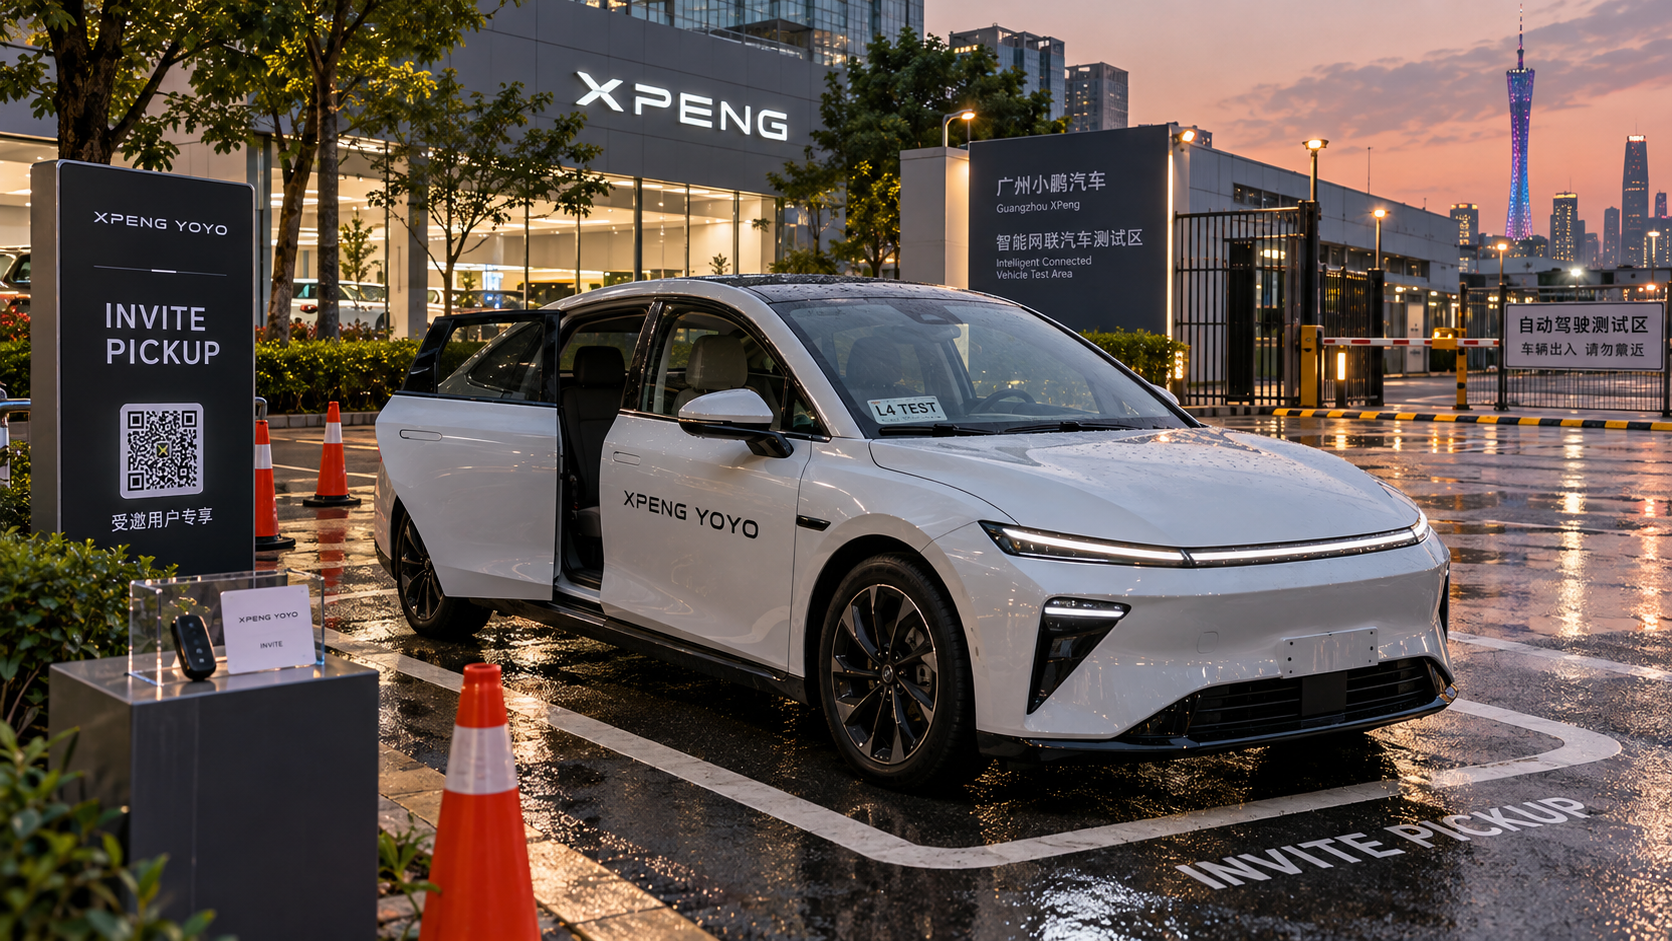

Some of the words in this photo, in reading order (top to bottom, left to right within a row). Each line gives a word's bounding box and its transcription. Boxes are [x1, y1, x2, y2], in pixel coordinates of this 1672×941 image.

[575, 70, 788, 142] XPENG
[996, 170, 1106, 197] 广州小鹏汽车
[996, 202, 1048, 214] Guangzhou
[1050, 200, 1080, 211] XPeng
[93, 211, 167, 230] XPENG
[174, 219, 228, 236] YOYO
[996, 228, 1143, 251] 智能网联汽车测试区
[996, 257, 1039, 270] Intelligent
[1042, 255, 1092, 267] Connected
[996, 269, 1028, 280] Vehicle
[1031, 269, 1049, 279] Test
[1051, 268, 1073, 279] Area
[105, 302, 206, 332] INVITE
[1519, 315, 1649, 334] 自动驾驶测试区
[106, 338, 221, 365] PICKUP
[875, 404, 896, 417] L4
[897, 402, 936, 415] TEST
[111, 506, 213, 533] 受邀用户专享
[623, 489, 687, 521] XPENG
[695, 506, 759, 539] YOYO
[239, 614, 271, 623] XPENG
[274, 611, 299, 619] YOYO
[260, 641, 283, 649] INVITE
[1175, 832, 1406, 891] INVITE
[1385, 797, 1591, 849] PICKUP
